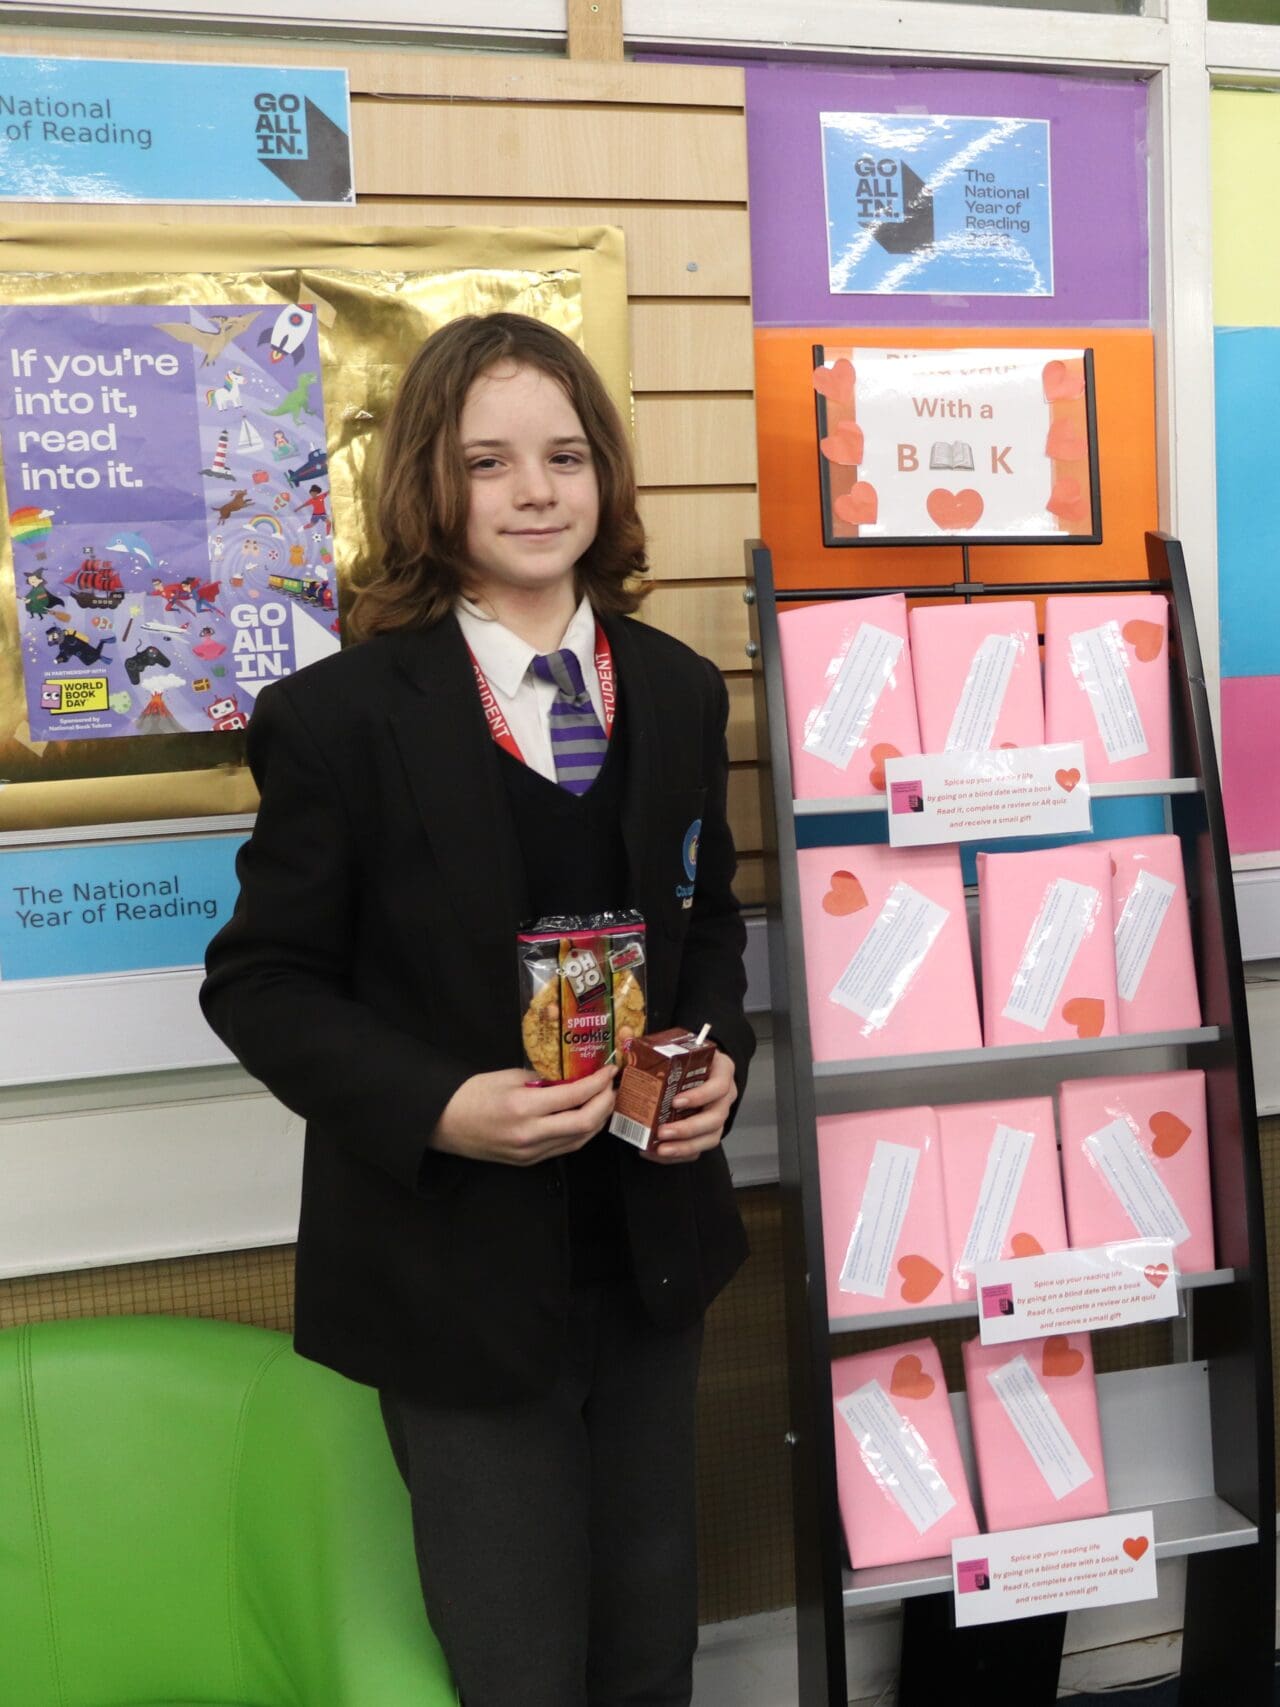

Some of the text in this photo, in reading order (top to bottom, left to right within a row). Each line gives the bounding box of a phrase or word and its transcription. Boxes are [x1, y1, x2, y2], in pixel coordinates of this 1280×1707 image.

[0, 95, 110, 119] National
[254, 93, 300, 113] GO
[255, 114, 301, 134] ALL
[6, 120, 153, 149] of Reading
[257, 135, 303, 155] IN.
[854, 158, 898, 178] GO
[964, 169, 996, 183] The
[855, 178, 898, 198] ALL
[964, 185, 1030, 200] National
[857, 199, 900, 218] IN.
[965, 200, 1022, 215] Year of
[966, 216, 1030, 233] Reading
[10, 347, 180, 384] If you're
[14, 386, 138, 418] into it,
[912, 397, 994, 420] With a
[18, 423, 118, 453] read
[21, 460, 144, 490] into it.
[230, 602, 288, 628] GO
[231, 628, 290, 654] ALL
[235, 652, 292, 679] IN.
[64, 682, 104, 691] WORLD
[66, 690, 96, 700] BOOK
[596, 652, 616, 724] STUDENT
[66, 699, 86, 708] DAY
[473, 665, 511, 738] STUDENT
[944, 778, 964, 786] Spice
[976, 776, 992, 785] your
[1022, 772, 1033, 780] life
[928, 794, 936, 802] by
[937, 793, 957, 803] going
[974, 790, 993, 798] blind
[994, 789, 1011, 797] date
[1012, 786, 1028, 794] with
[1034, 785, 1052, 793] book
[936, 807, 956, 816] Read
[956, 806, 964, 814] it,
[966, 802, 1000, 814] complete
[1007, 801, 1030, 809] review
[1051, 798, 1067, 806] quiz
[949, 820, 964, 828] and
[964, 818, 991, 827] receive
[998, 816, 1018, 824] small
[1020, 814, 1032, 822] gift
[13, 875, 180, 906] The National
[16, 898, 218, 929] Year of Reading
[568, 1014, 608, 1028] SPOTTED
[564, 1030, 612, 1044] Cookie
[1010, 1554, 1031, 1563] Spice
[1043, 1550, 1060, 1558] your
[1060, 1546, 1088, 1554] reading
[1089, 1543, 1100, 1551] life
[1003, 1570, 1022, 1579] going
[1041, 1564, 1060, 1572] blind
[1061, 1562, 1078, 1570] date
[1078, 1559, 1094, 1567] with
[1101, 1555, 1120, 1564] book
[1003, 1584, 1022, 1592] Read
[1022, 1582, 1030, 1590] it,
[1032, 1576, 1066, 1588] complete
[1074, 1572, 1098, 1580] review
[1107, 1568, 1118, 1576] AR
[1119, 1566, 1134, 1576] quiz
[1015, 1596, 1029, 1604] and
[1030, 1592, 1058, 1601] receive
[1064, 1587, 1085, 1596] small
[1086, 1585, 1098, 1594] gift
